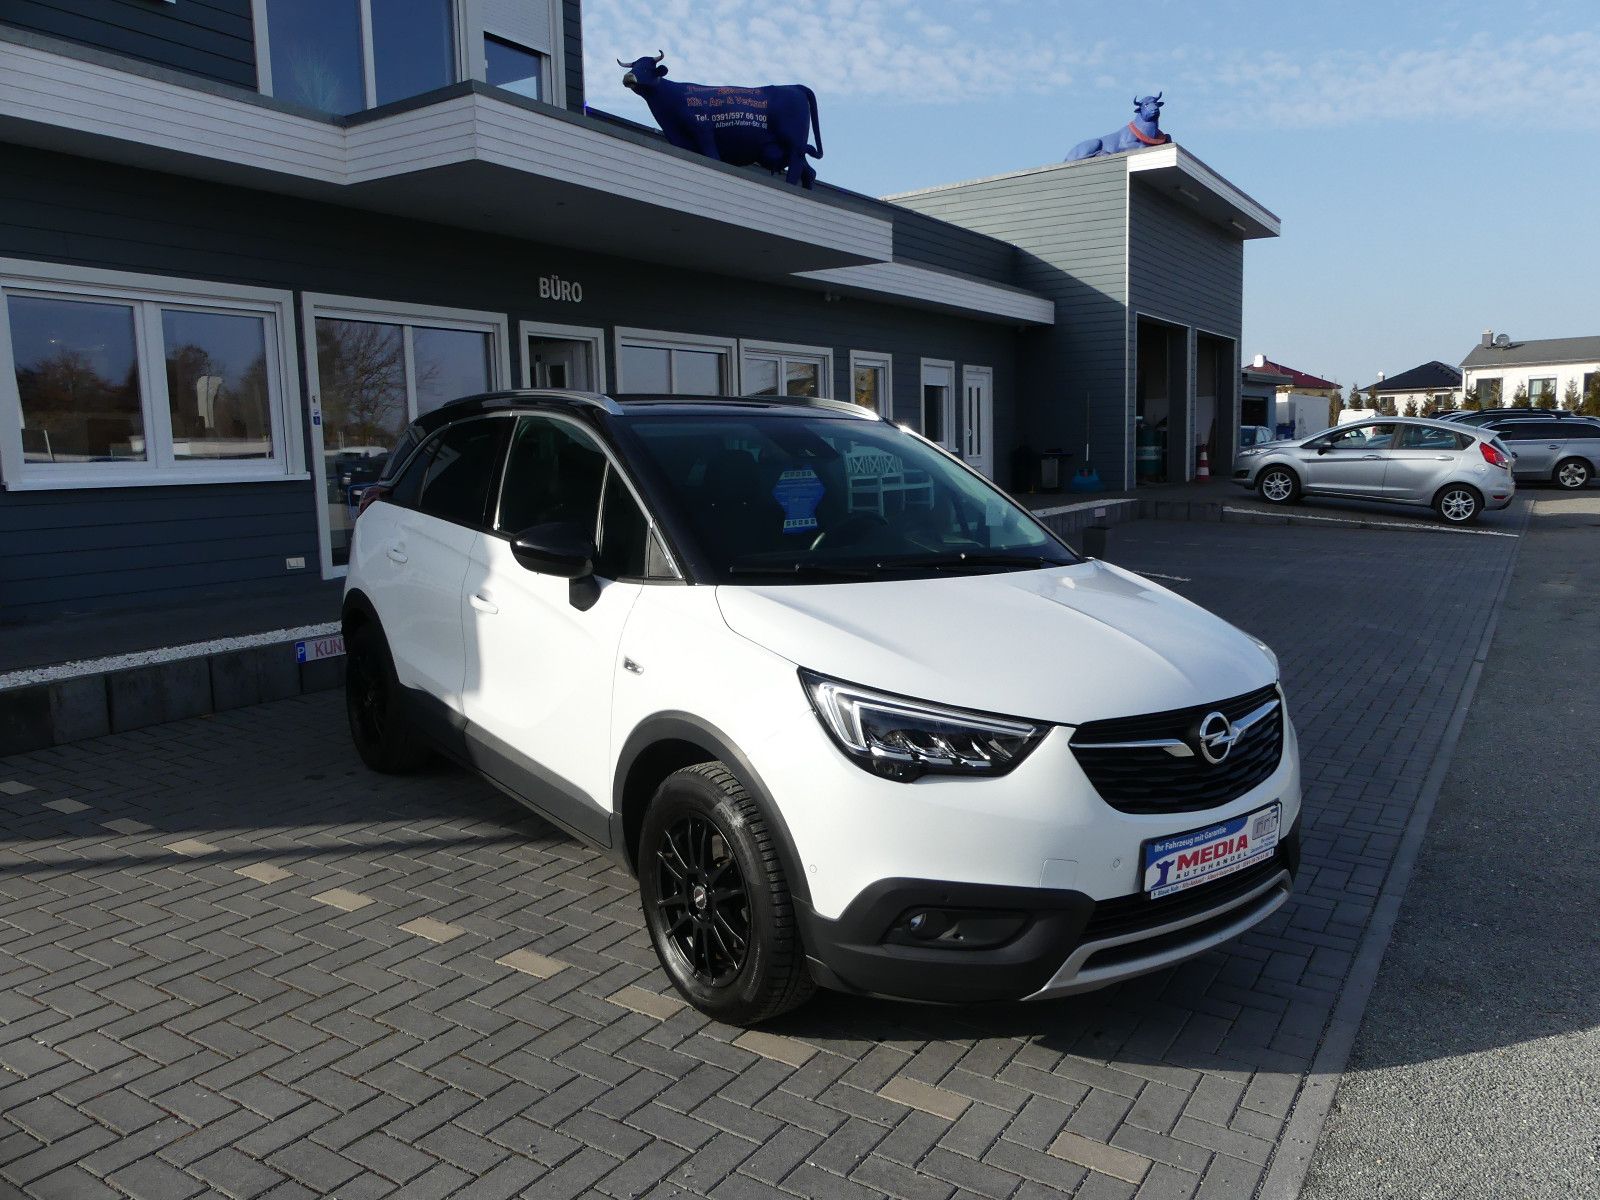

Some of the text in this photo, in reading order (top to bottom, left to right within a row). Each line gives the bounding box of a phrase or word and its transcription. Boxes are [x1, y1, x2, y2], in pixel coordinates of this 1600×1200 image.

[711, 112, 744, 121] 0391/597
[755, 114, 767, 122] 100
[539, 274, 583, 303] BÜRO
[297, 646, 305, 659] P
[1154, 827, 1227, 852] Ihr Fahrzeug mit Garantie
[1176, 835, 1248, 871] MEDIA
[1176, 851, 1247, 879] AUTOHANDEL
